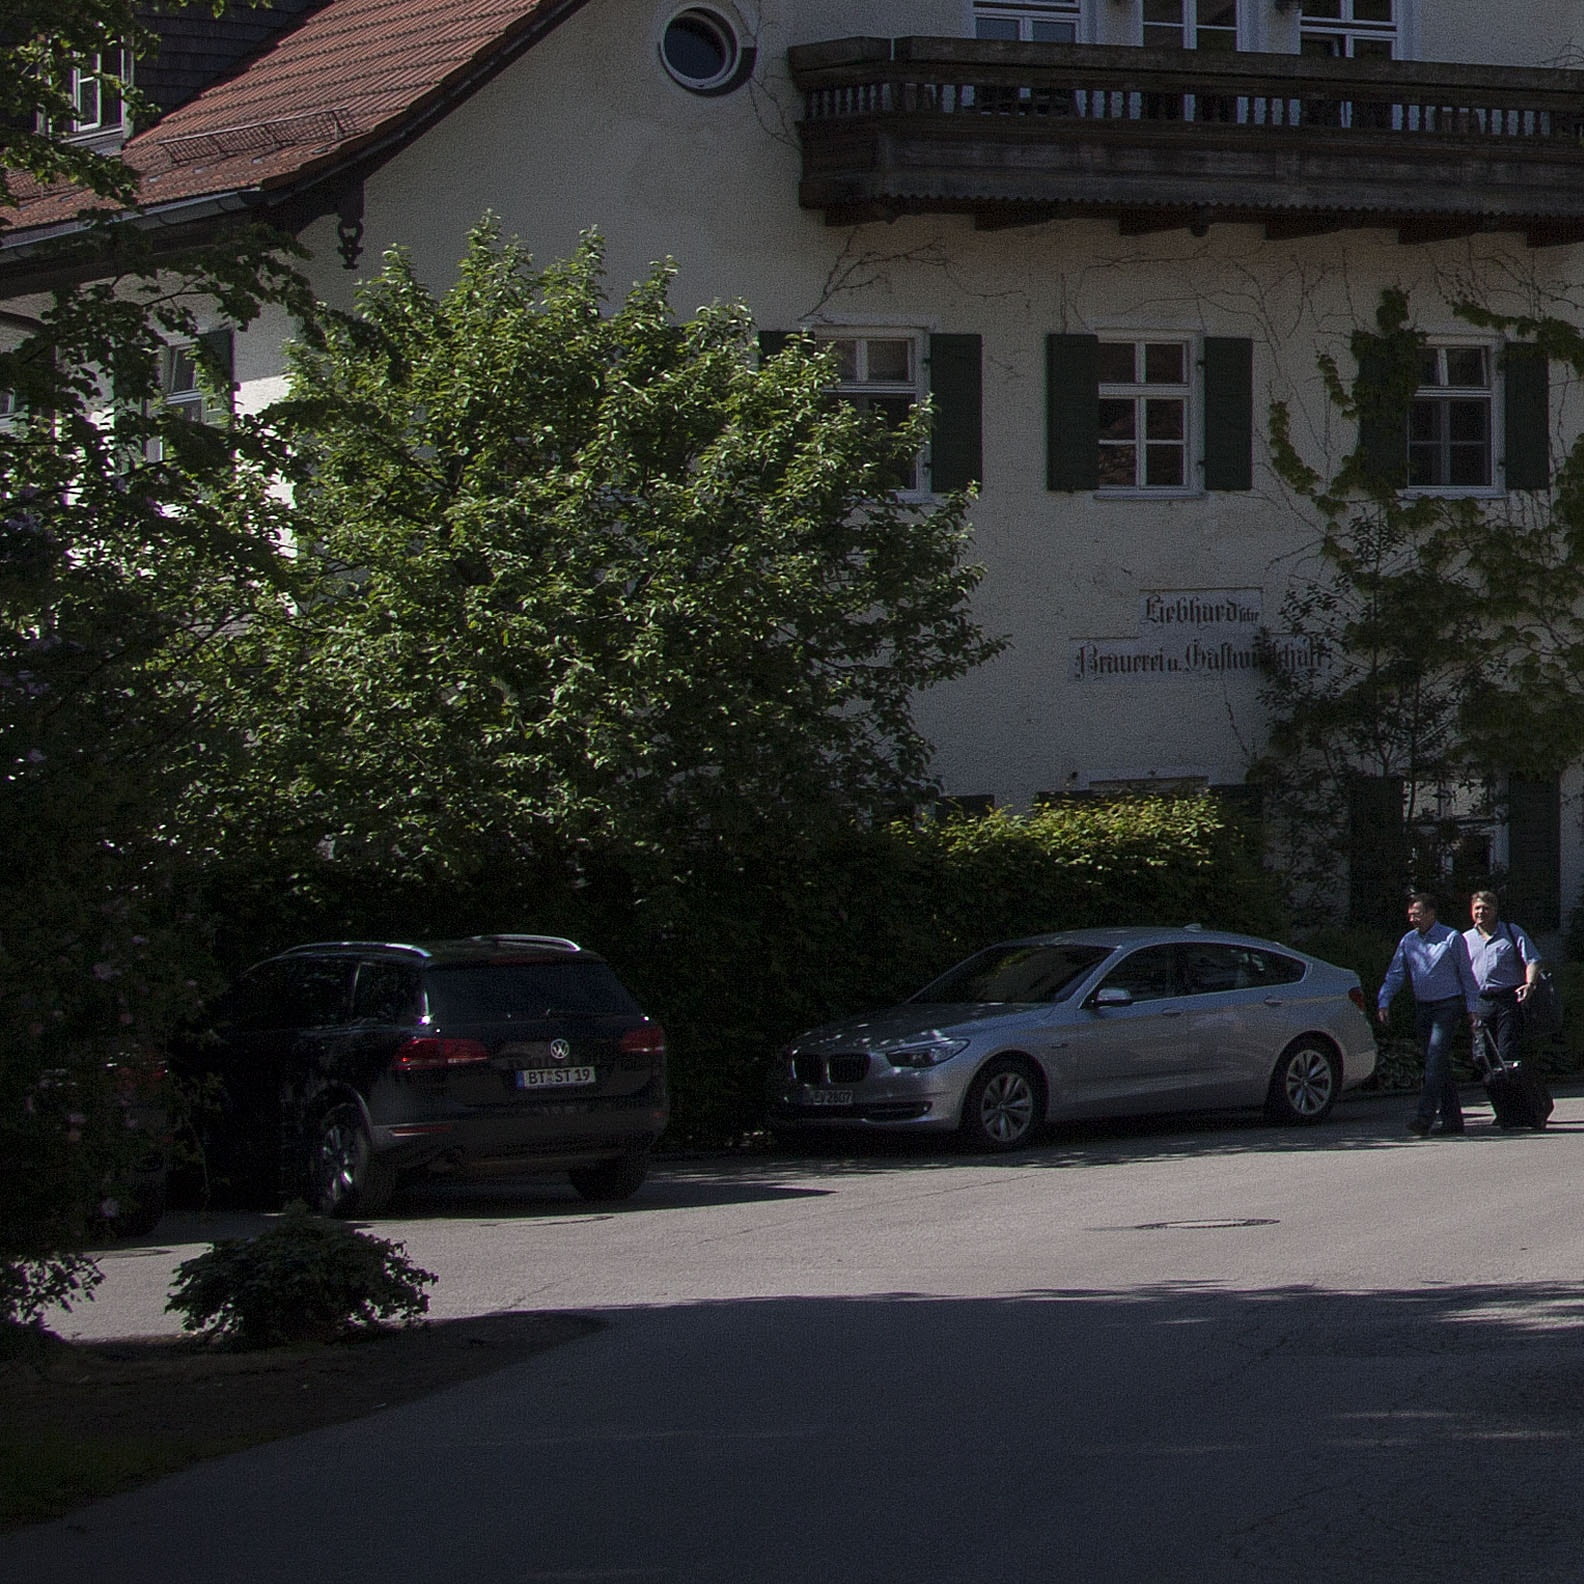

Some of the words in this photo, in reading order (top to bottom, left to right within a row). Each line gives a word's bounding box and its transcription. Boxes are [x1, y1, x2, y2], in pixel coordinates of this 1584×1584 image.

[1075, 644, 1164, 677] Brauerei
[528, 1070, 546, 1085] BT
[554, 1069, 571, 1084] ST
[575, 1068, 590, 1082] 19
